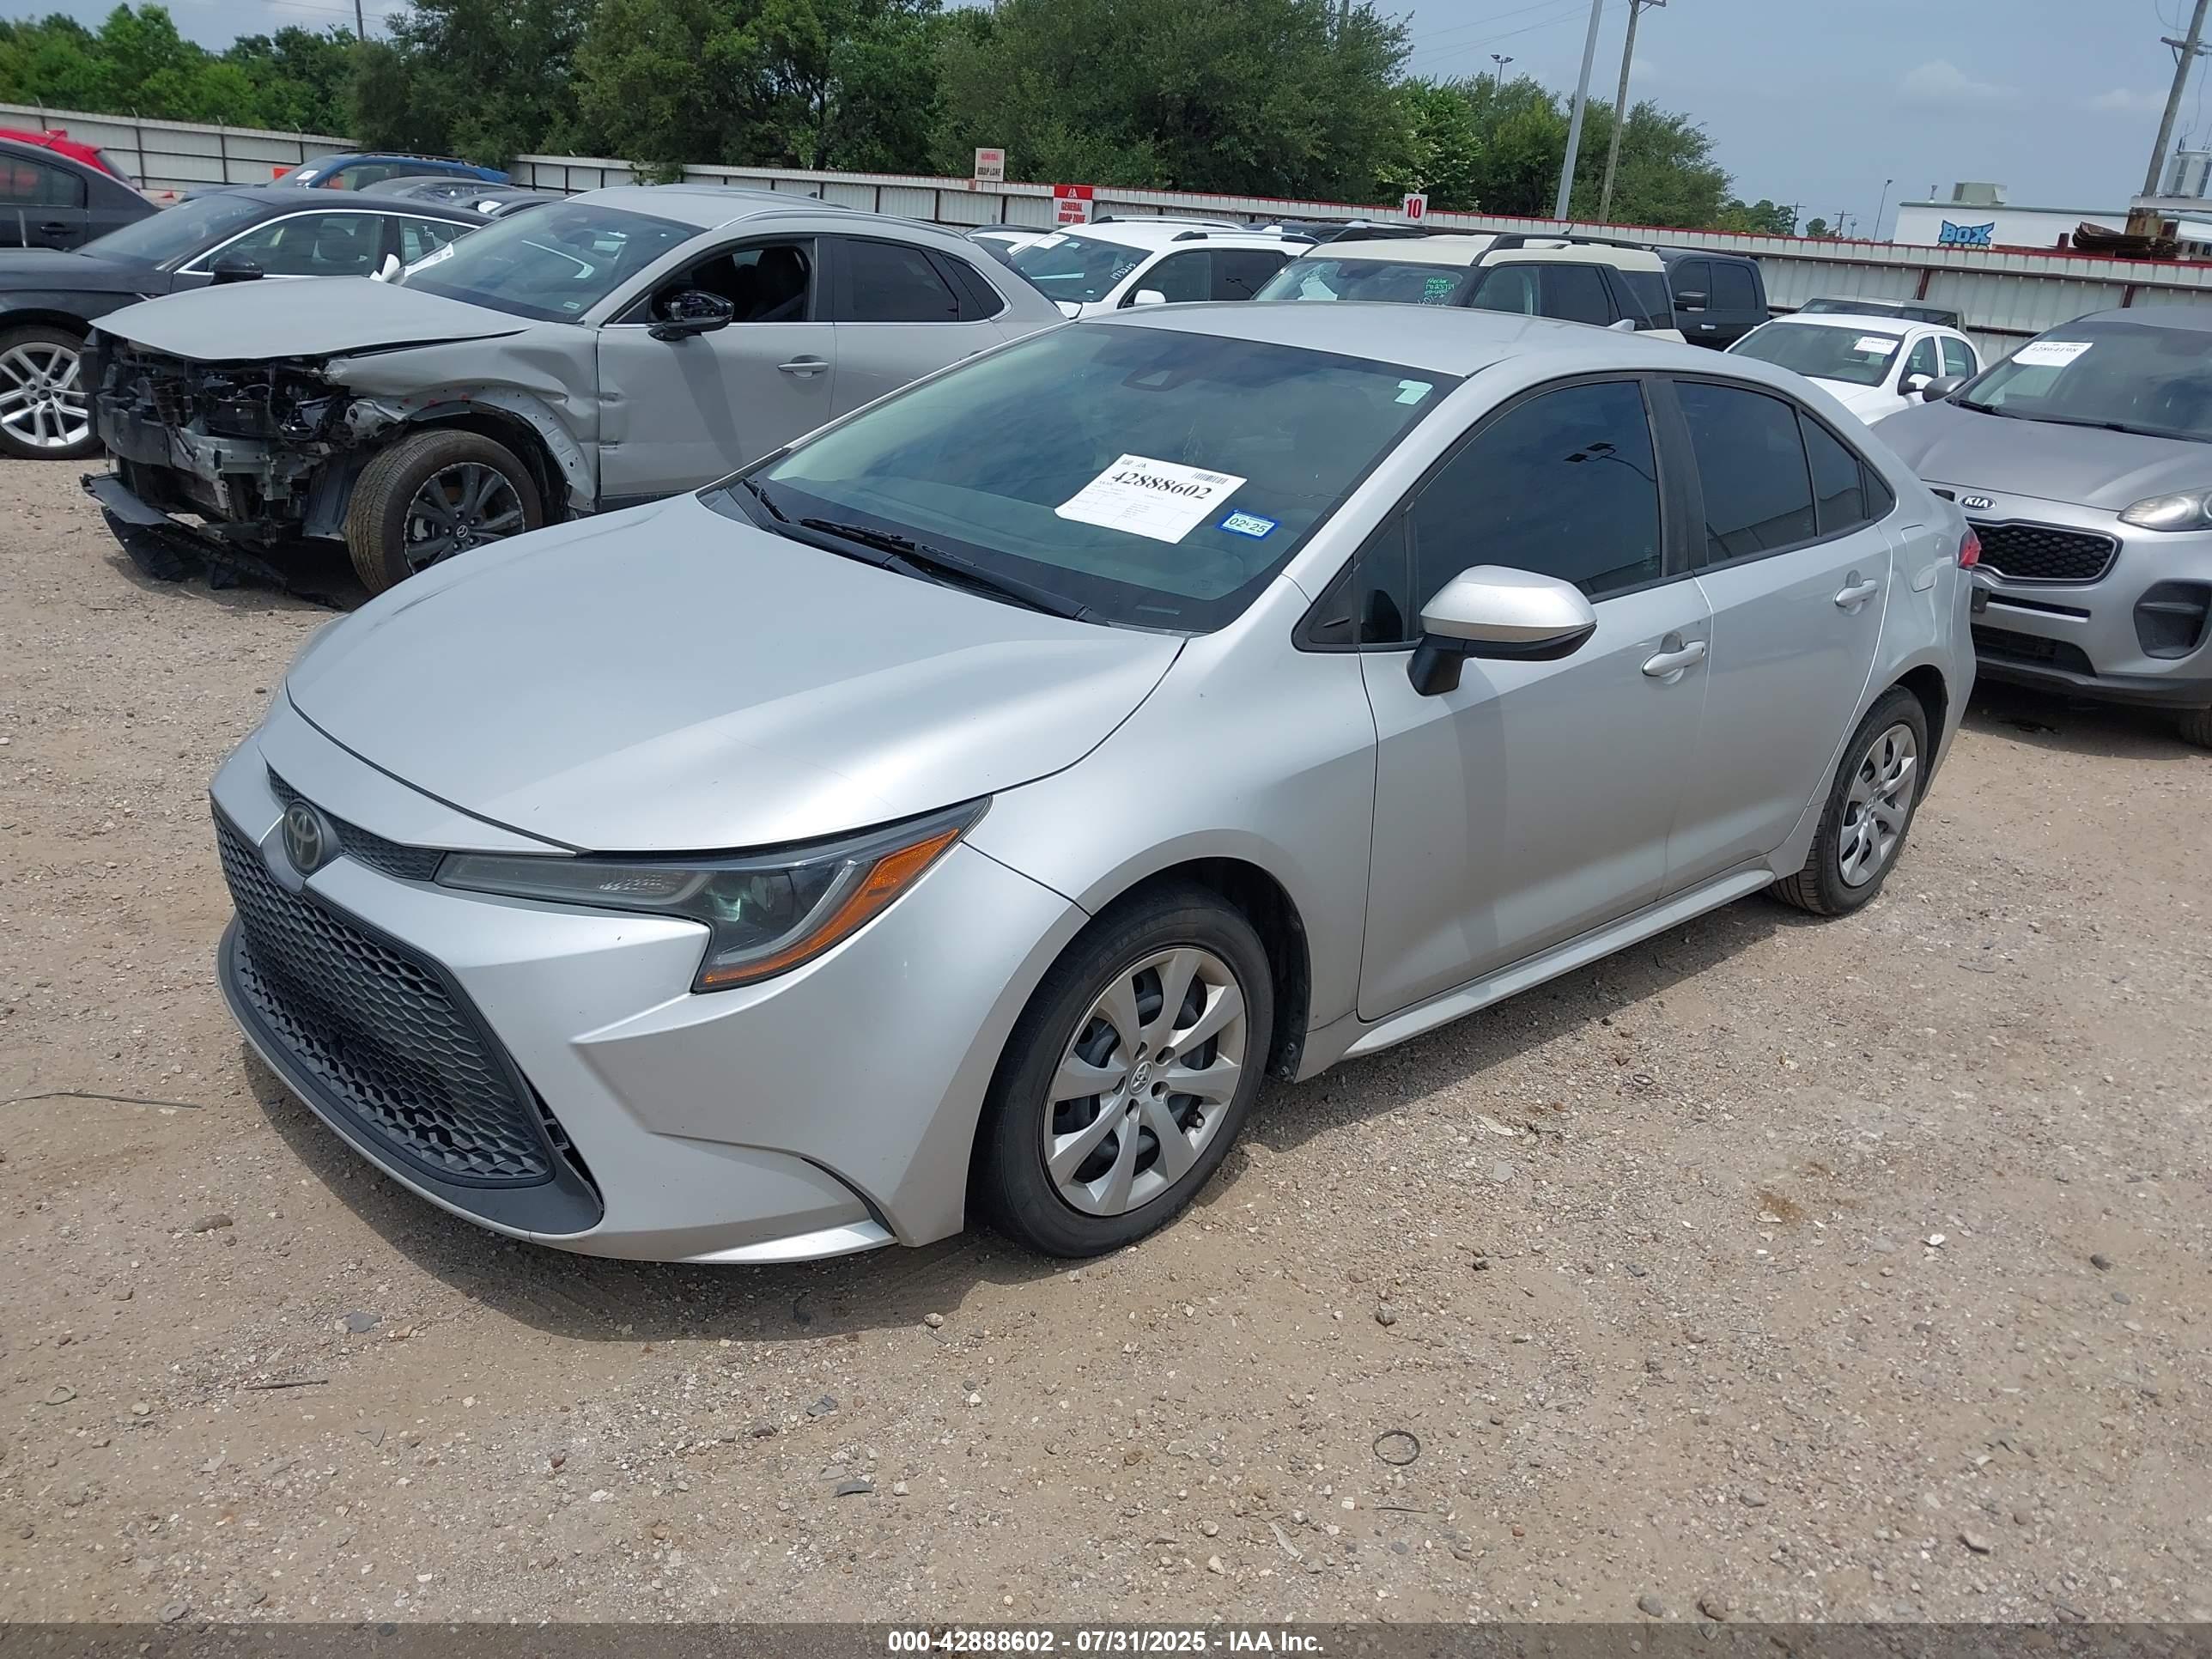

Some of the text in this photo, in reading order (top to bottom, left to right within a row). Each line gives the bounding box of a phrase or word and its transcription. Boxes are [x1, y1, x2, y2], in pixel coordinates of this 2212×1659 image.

[1060, 200, 1083, 212] GENERAL
[1406, 198, 1423, 219] 10
[1058, 212, 1086, 224] DROP ZONE
[1938, 219, 1995, 246] BOX
[1111, 471, 1212, 500] 42888602
[1964, 496, 1989, 508] KIA
